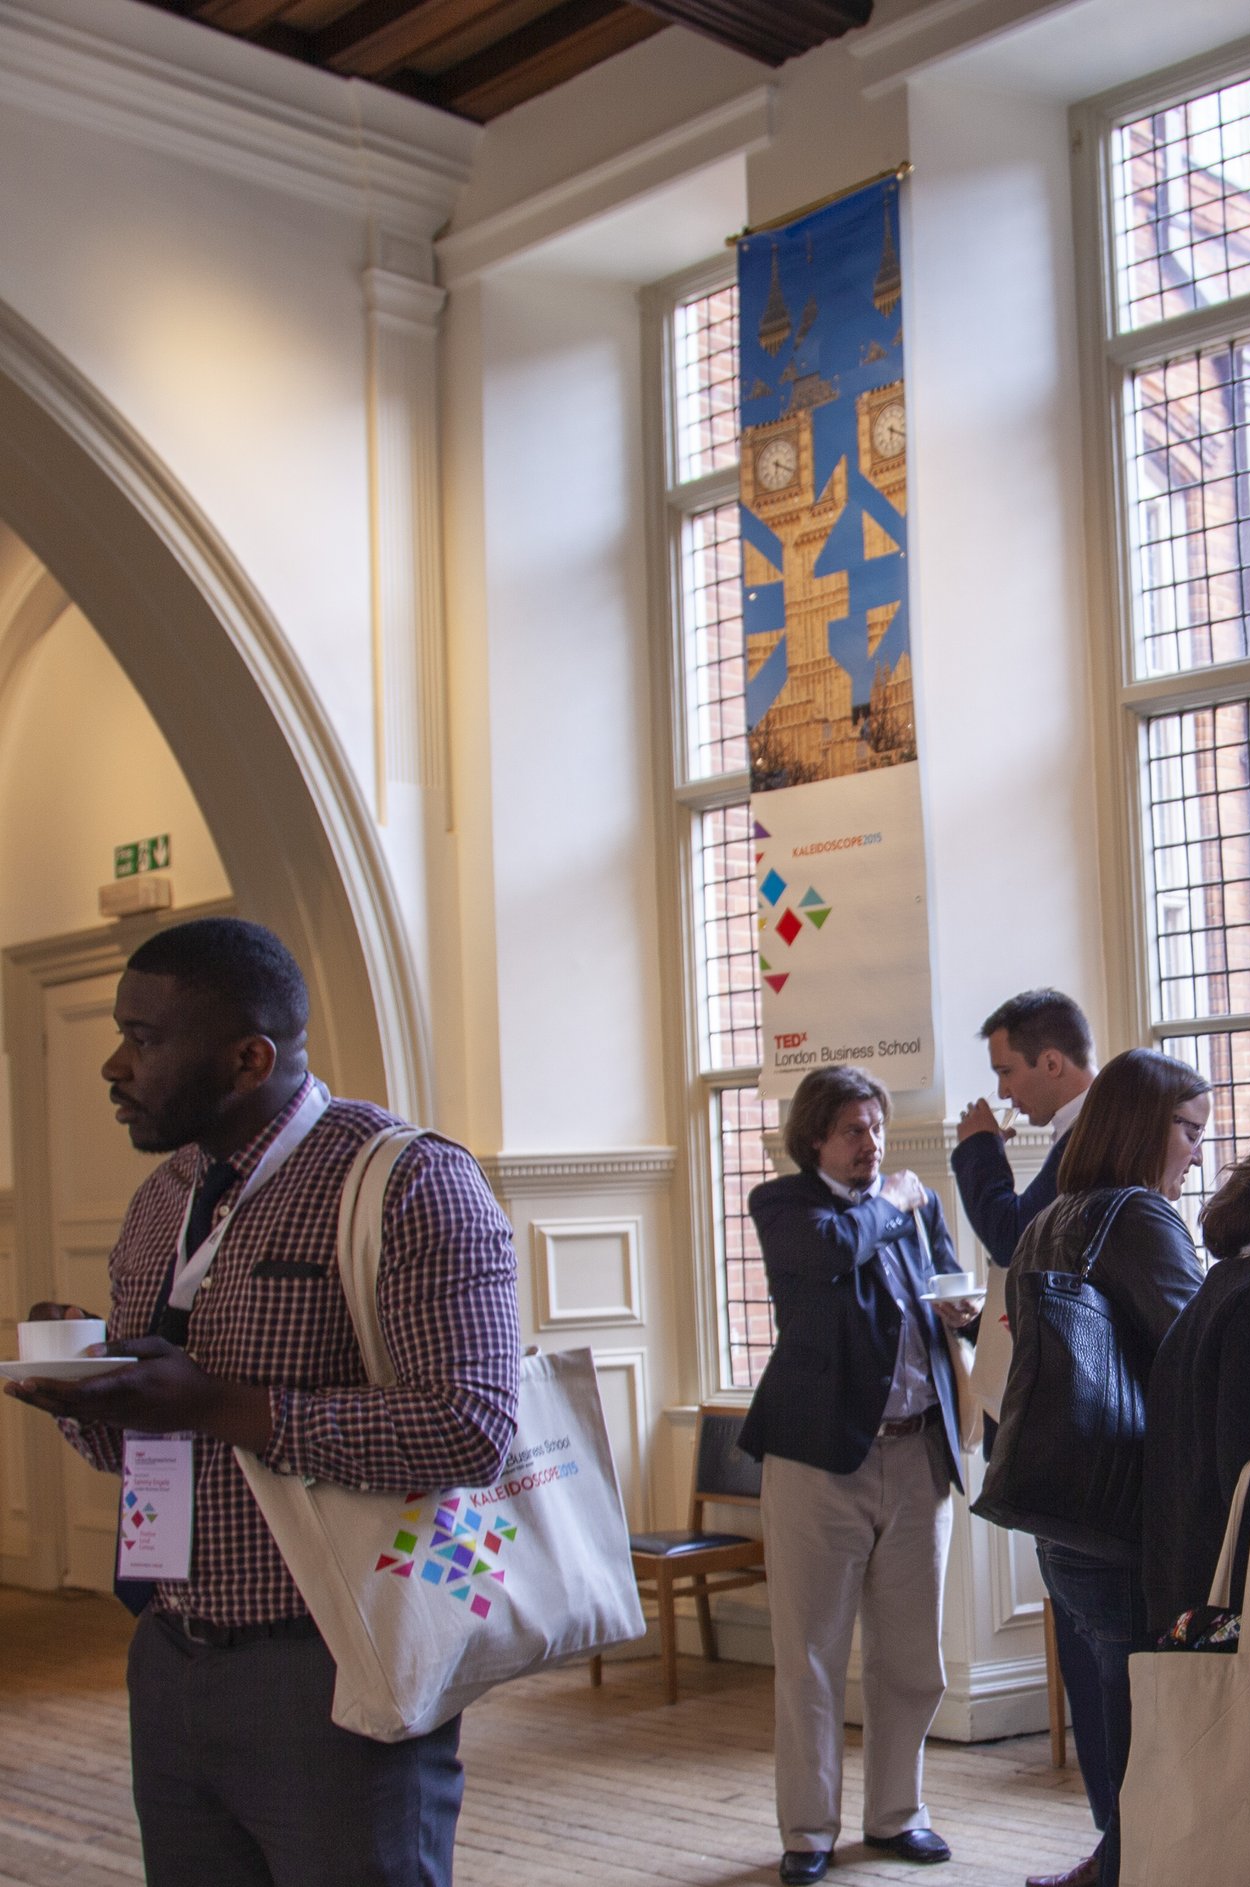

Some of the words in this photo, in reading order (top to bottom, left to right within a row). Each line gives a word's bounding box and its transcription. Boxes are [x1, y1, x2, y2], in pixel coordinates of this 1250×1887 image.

[793, 832, 882, 857] KALEIDOSCOPE2015
[774, 1032, 808, 1049] TEDx
[775, 1051, 816, 1067] London
[821, 1045, 874, 1062] Business
[878, 1037, 921, 1057] School
